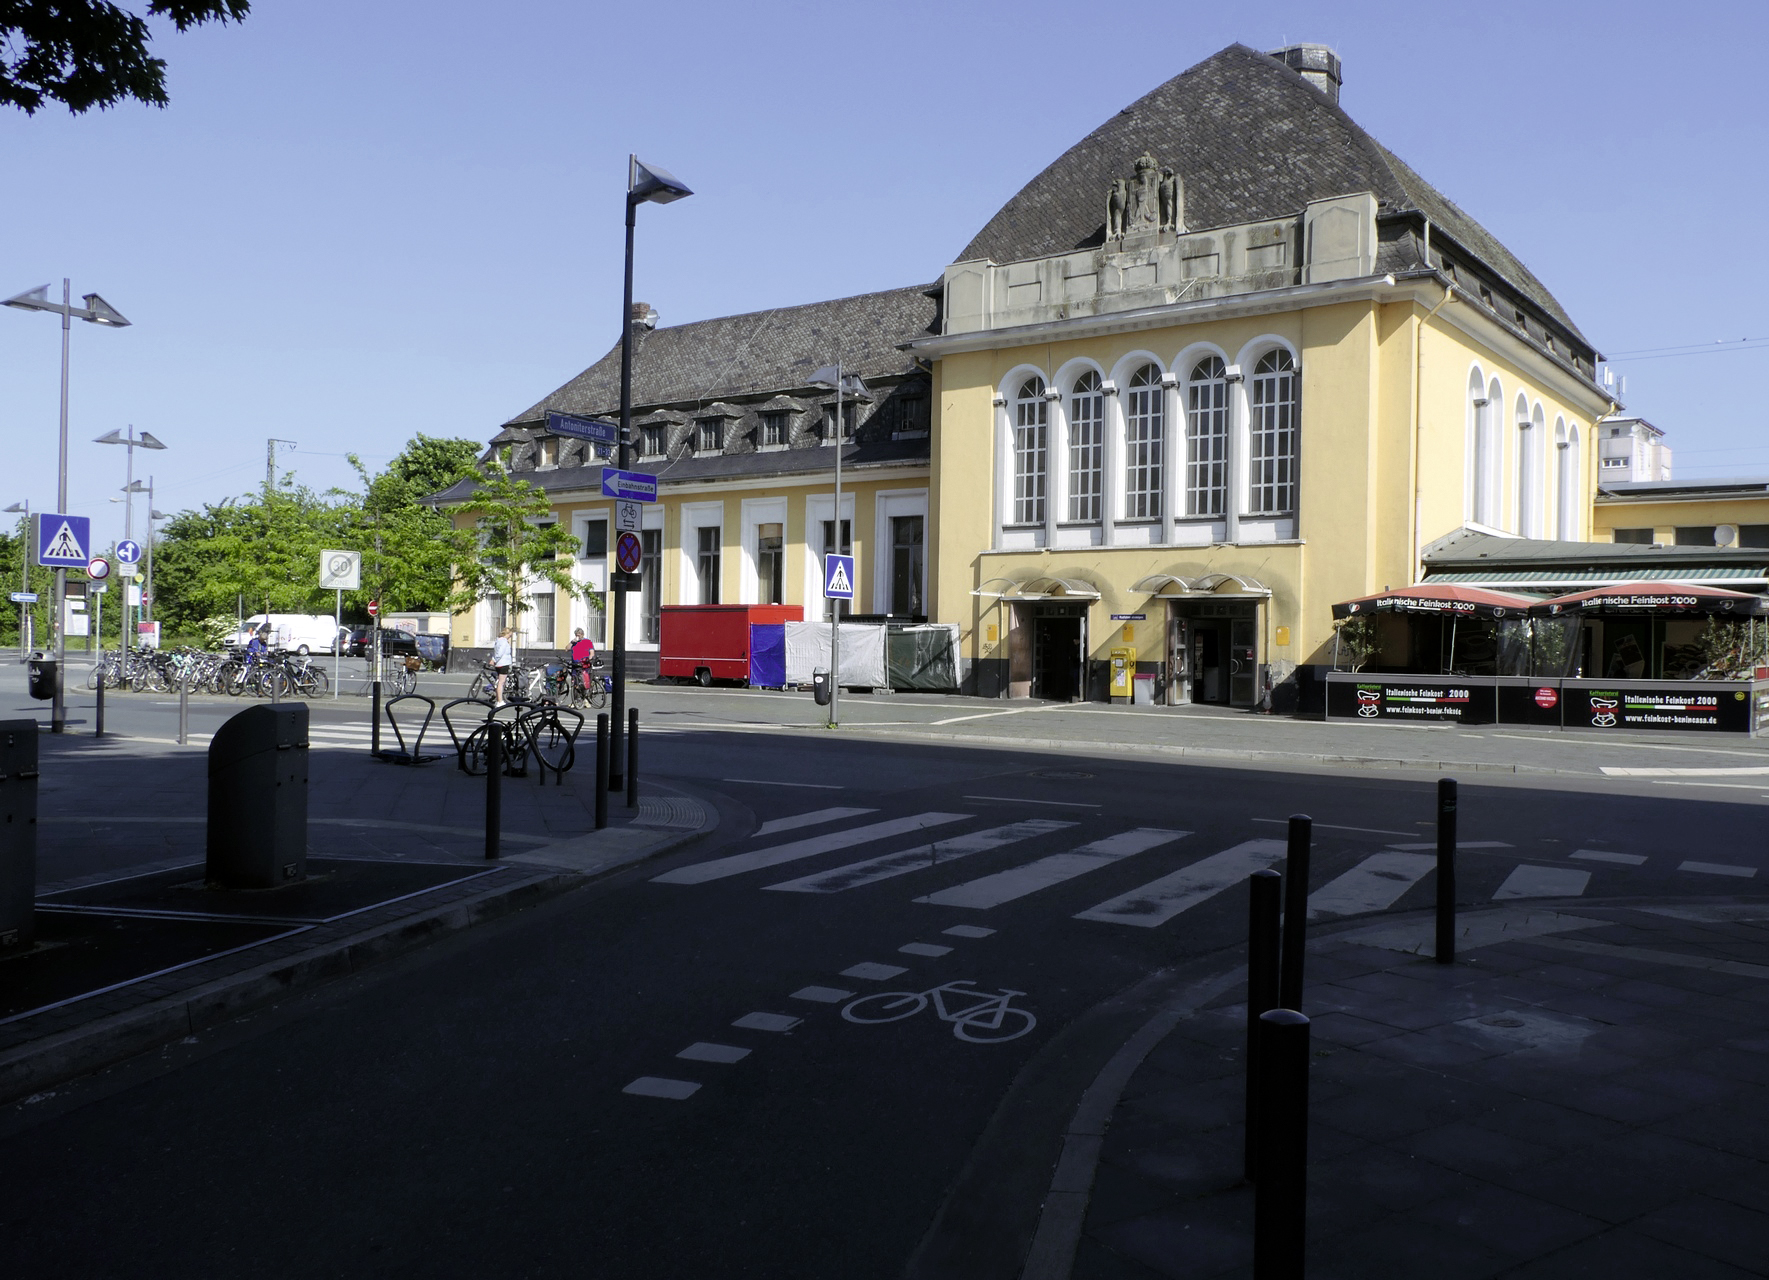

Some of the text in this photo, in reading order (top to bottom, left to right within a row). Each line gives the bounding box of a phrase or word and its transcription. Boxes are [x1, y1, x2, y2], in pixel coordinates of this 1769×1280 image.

[560, 418, 606, 437] Antoniterstraße
[617, 480, 654, 492] Einbahnstraße
[333, 560, 348, 571] 30
[1418, 598, 1451, 609] Feinkost
[1452, 601, 1475, 611] 2000
[1581, 596, 1697, 607] Italienische Feinkost 2000
[1385, 688, 1469, 698] Italienische Feinkost 2000
[1624, 695, 1717, 705] Italienische Feinkost 2000
[1625, 714, 1717, 725] www.feinkost-benincasa.de
